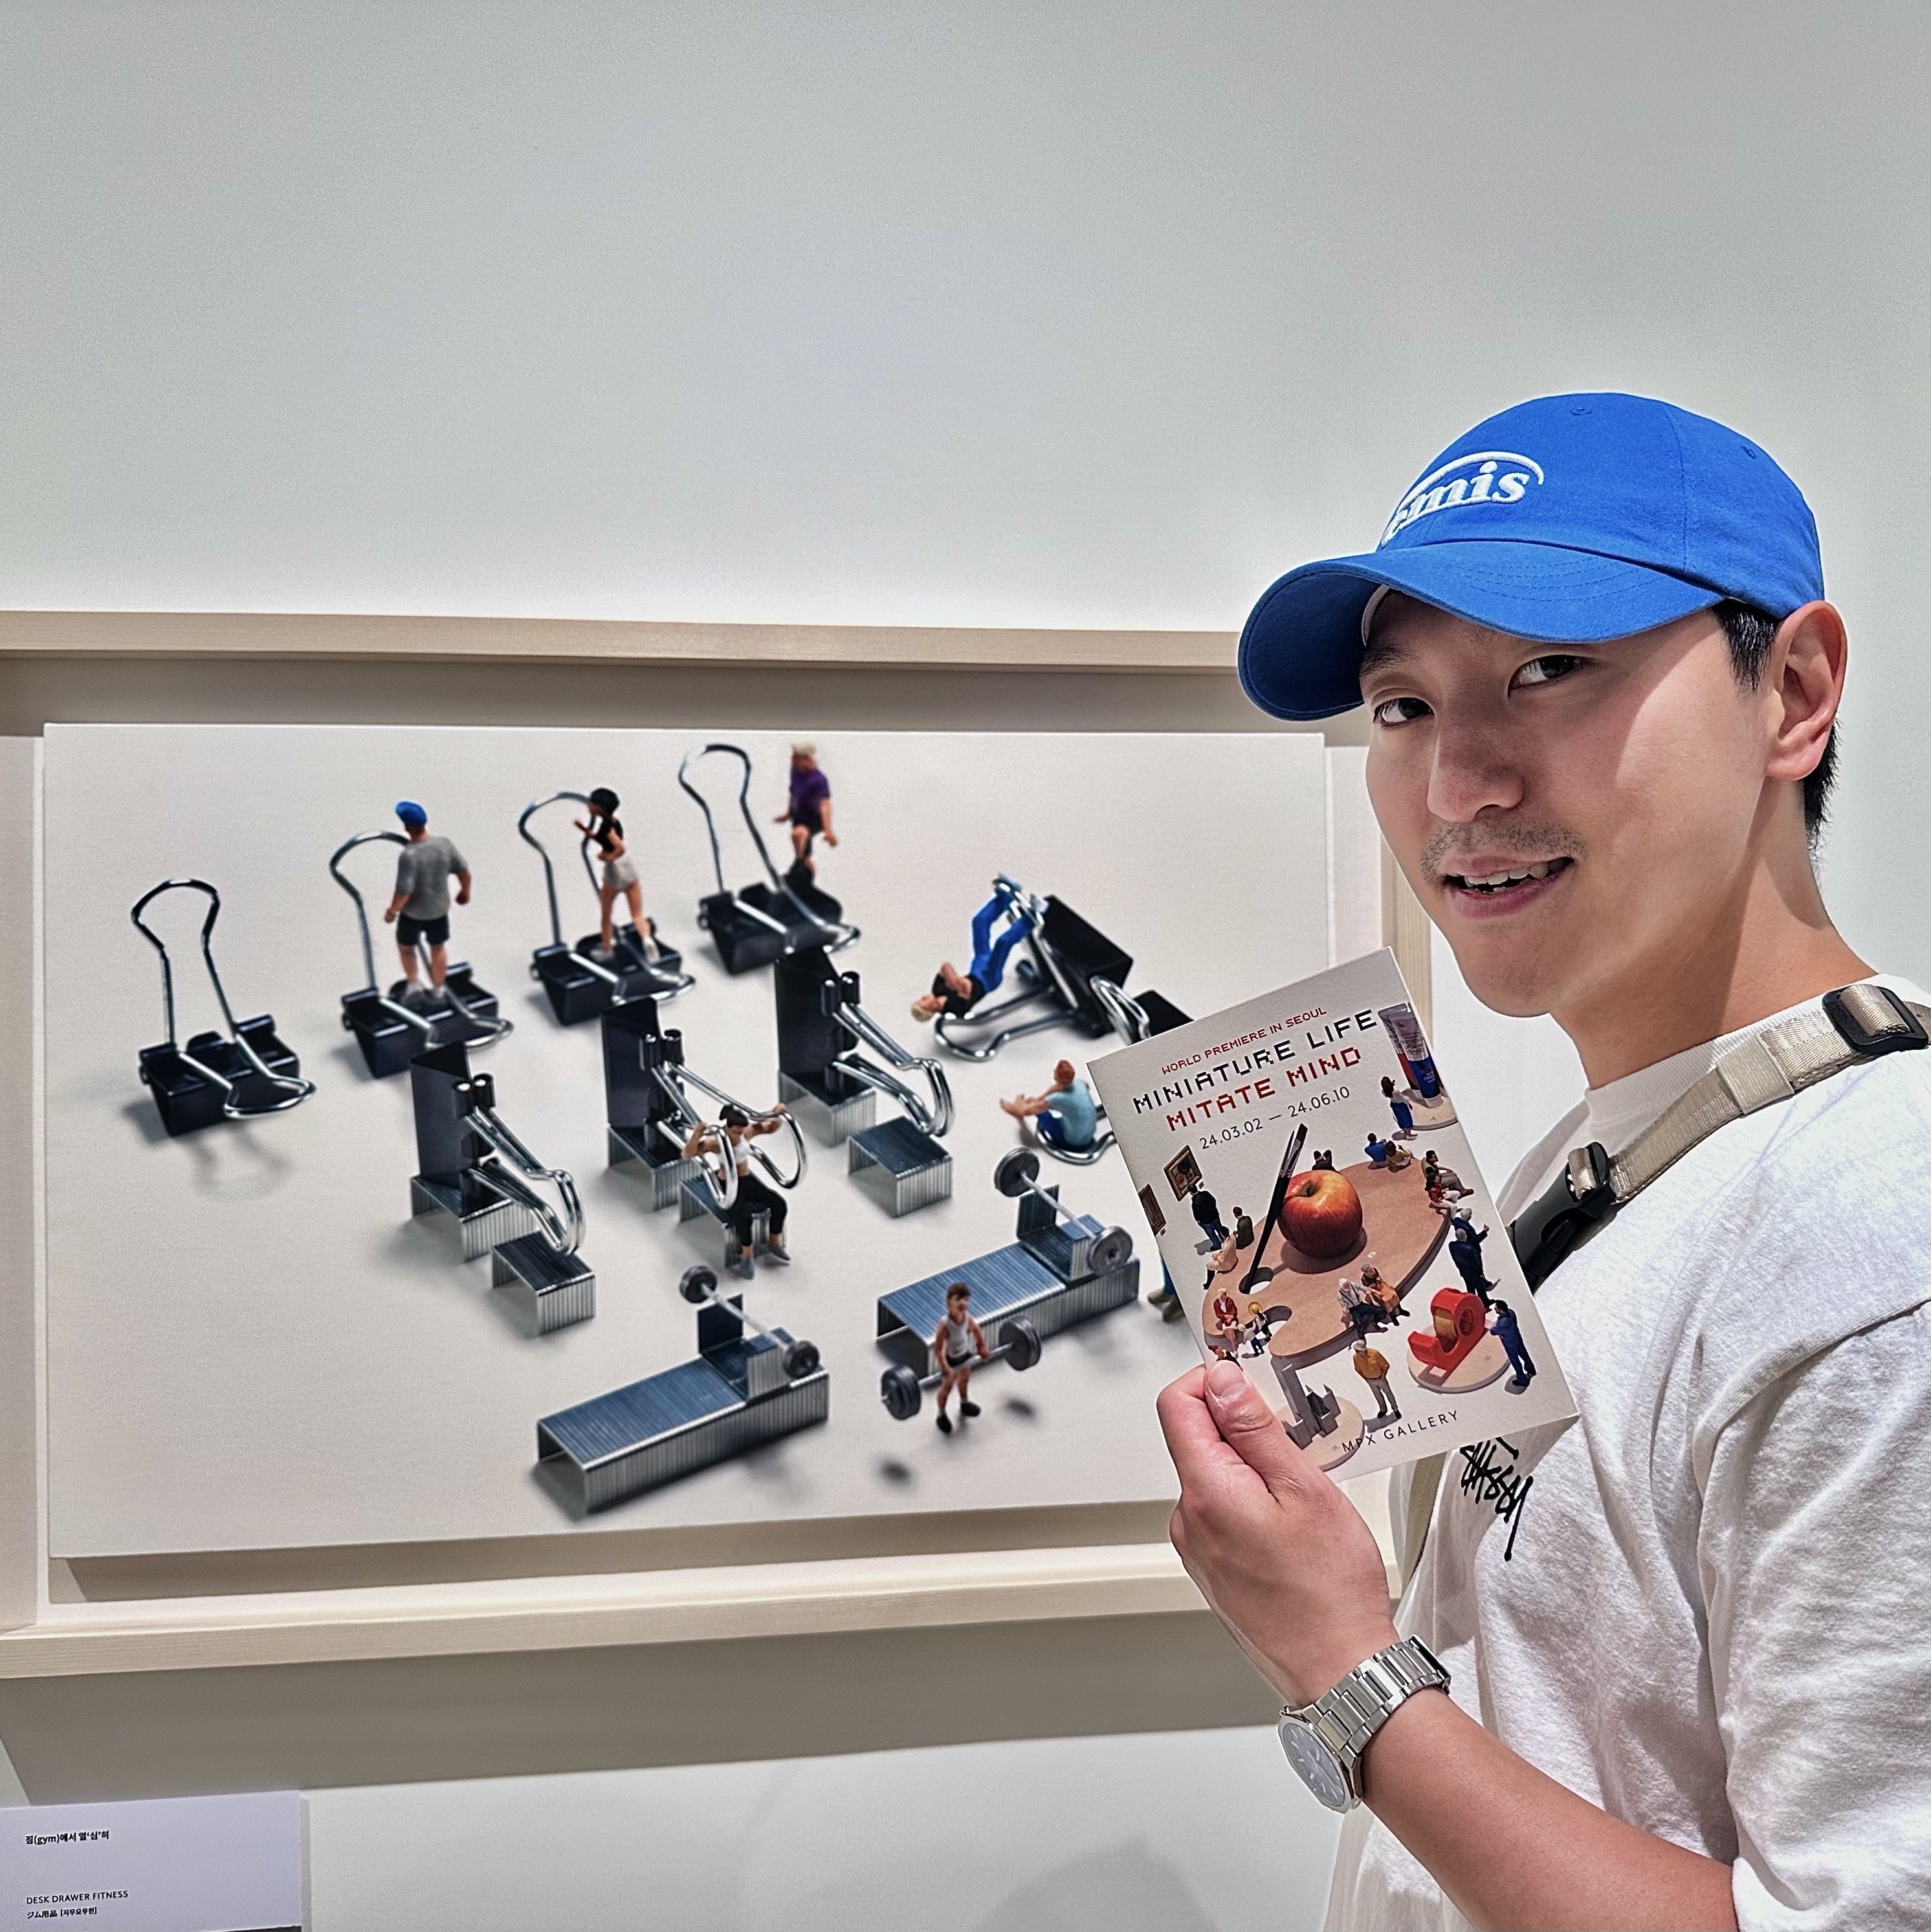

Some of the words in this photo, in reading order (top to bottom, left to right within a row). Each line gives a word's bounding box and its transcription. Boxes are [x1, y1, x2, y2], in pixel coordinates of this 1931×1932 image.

[1132, 1039, 1296, 1115] MINIATURE
[1306, 1009, 1378, 1049] LIFE
[1161, 1052, 1202, 1074] WORLD
[1204, 1028, 1268, 1059] PREMIERE
[1269, 1022, 1283, 1034] IN
[1285, 1007, 1327, 1028] SEOUL
[1166, 1078, 1276, 1131] MITATE
[1286, 1047, 1362, 1087] MIND
[1199, 1117, 1263, 1149] 24.03.02
[1287, 1085, 1350, 1118] 24.06.10
[1341, 1434, 1376, 1452] MPX
[1384, 1410, 1459, 1440] GALLERY
[27, 1896, 50, 1904] DESK
[52, 1893, 90, 1903] DRAWER
[93, 1890, 129, 1900] FITNESS
[27, 1910, 58, 1919] ジム用品
